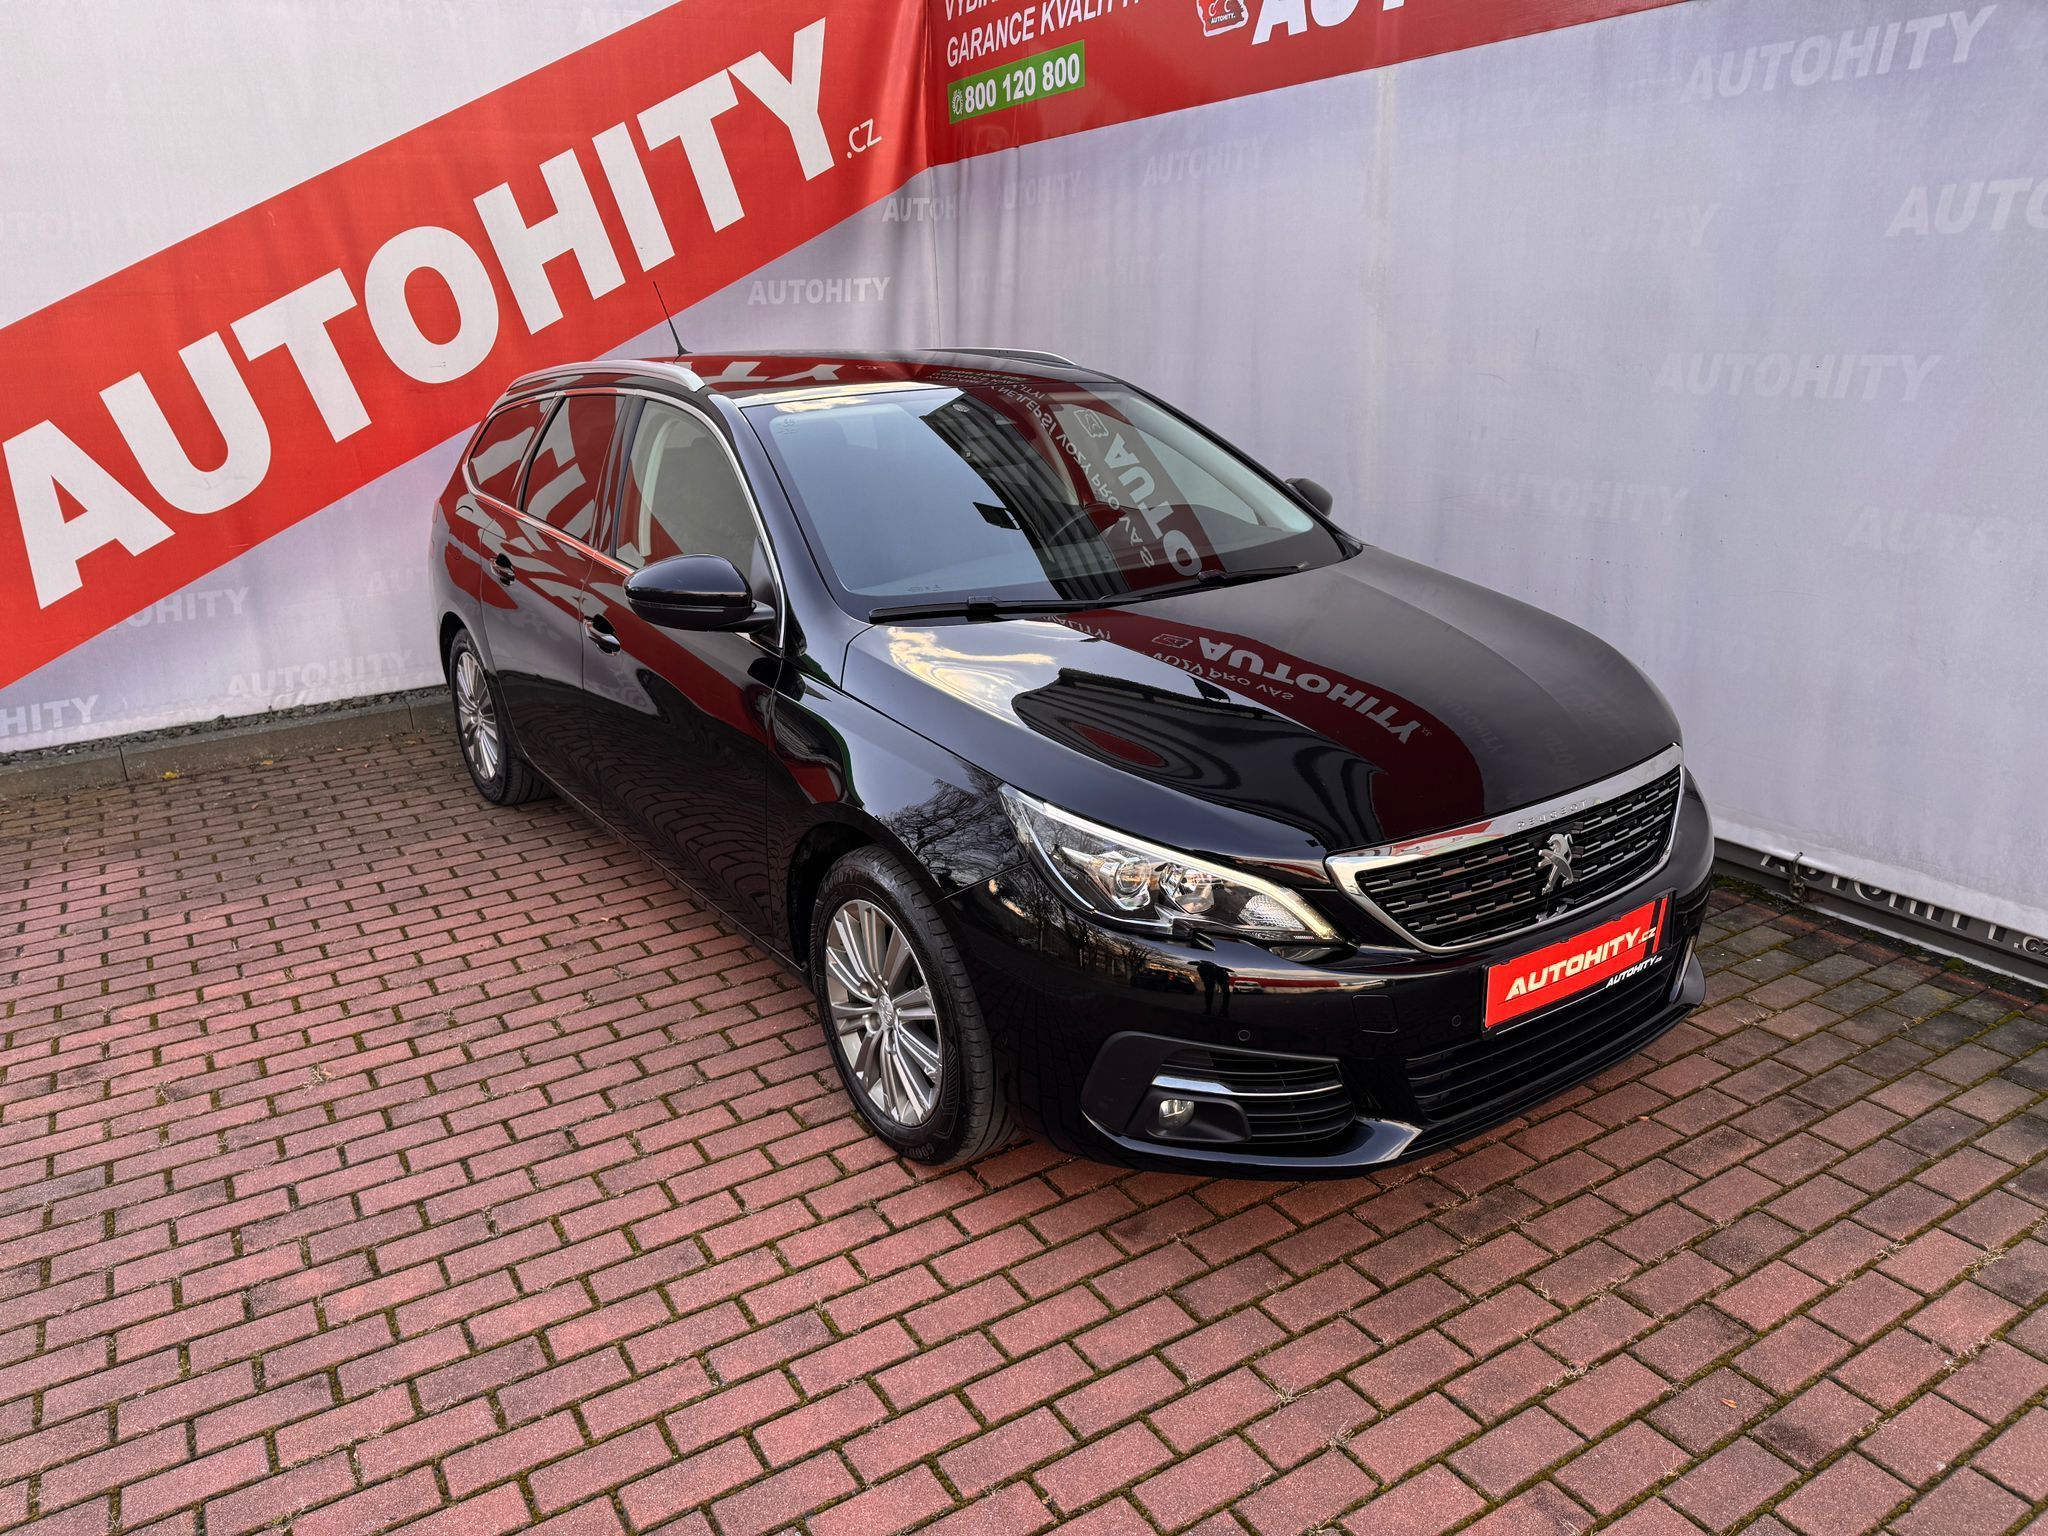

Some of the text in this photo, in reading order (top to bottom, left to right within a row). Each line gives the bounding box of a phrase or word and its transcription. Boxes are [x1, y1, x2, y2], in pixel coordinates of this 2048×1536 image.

[946, 6, 1036, 68] GARANCE
[1681, 5, 1998, 104] AUTOHITY
[964, 53, 1081, 113] 800 120 800
[748, 276, 891, 306] AUTOHITY
[1651, 352, 1944, 403] AUTOHITY
